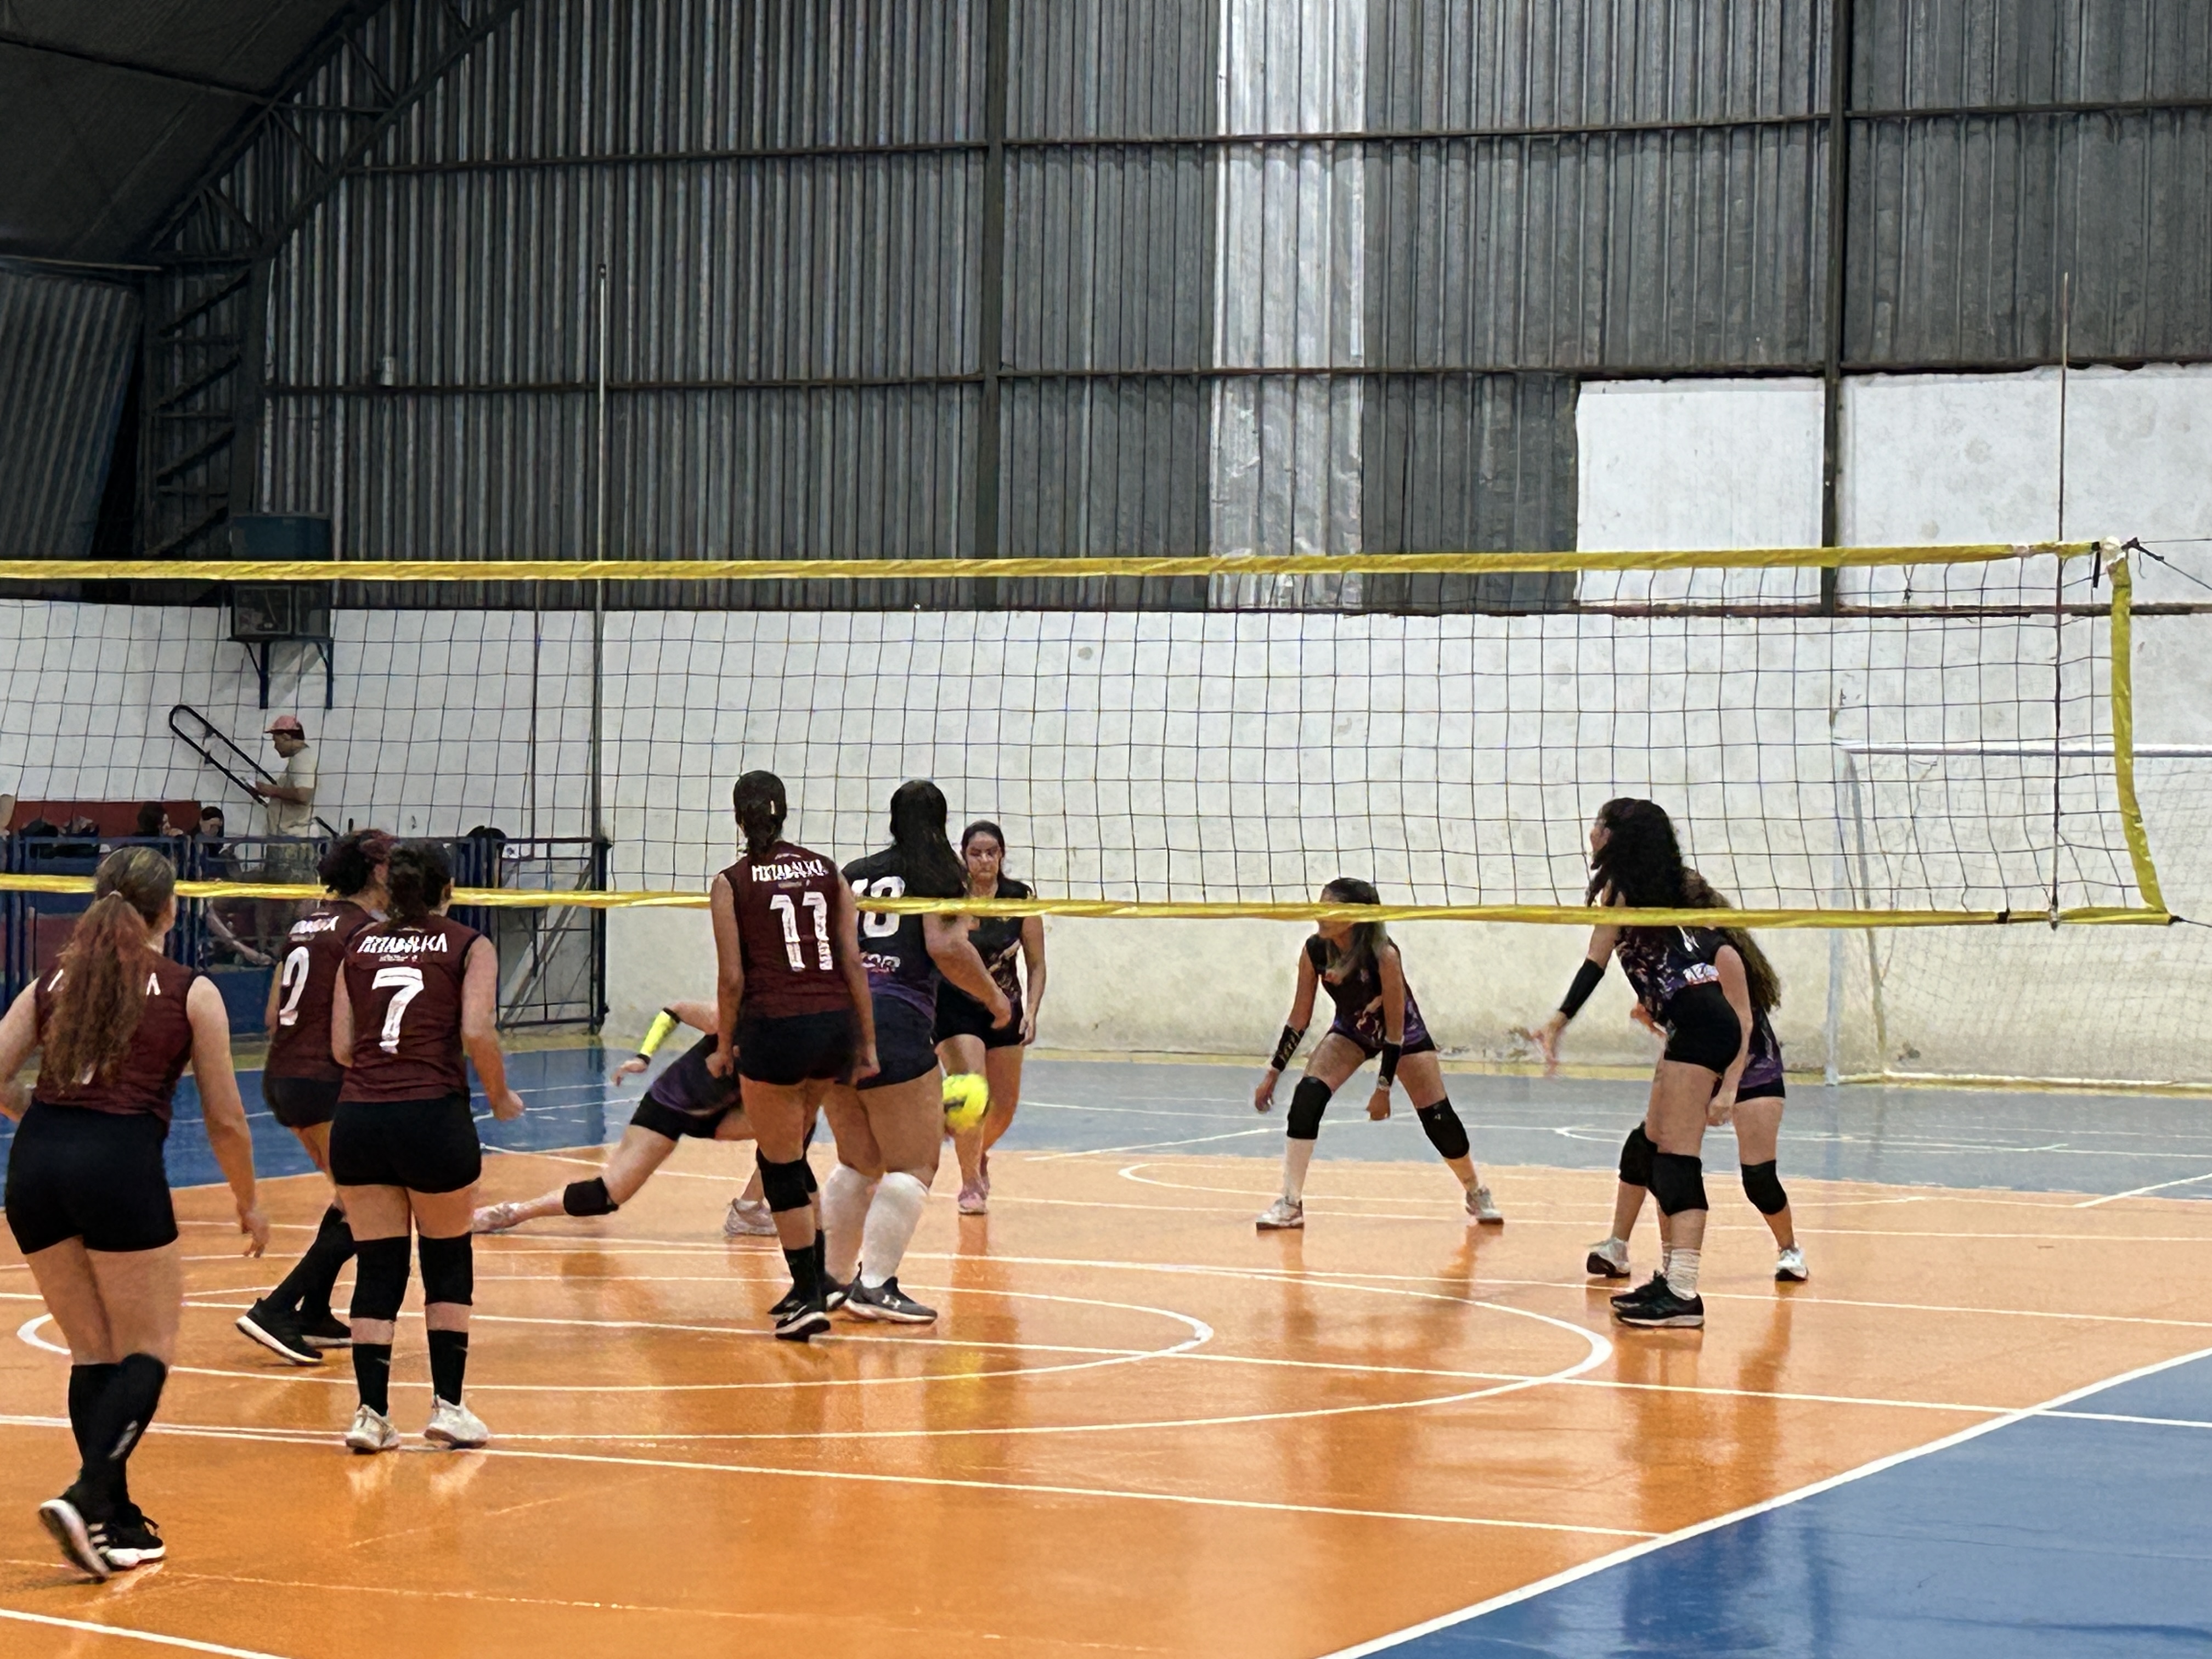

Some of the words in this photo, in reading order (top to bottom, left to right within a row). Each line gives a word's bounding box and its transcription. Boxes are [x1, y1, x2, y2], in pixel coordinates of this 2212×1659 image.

[770, 891, 833, 972] 11
[279, 946, 309, 1026] 2
[372, 966, 424, 1053] 7
